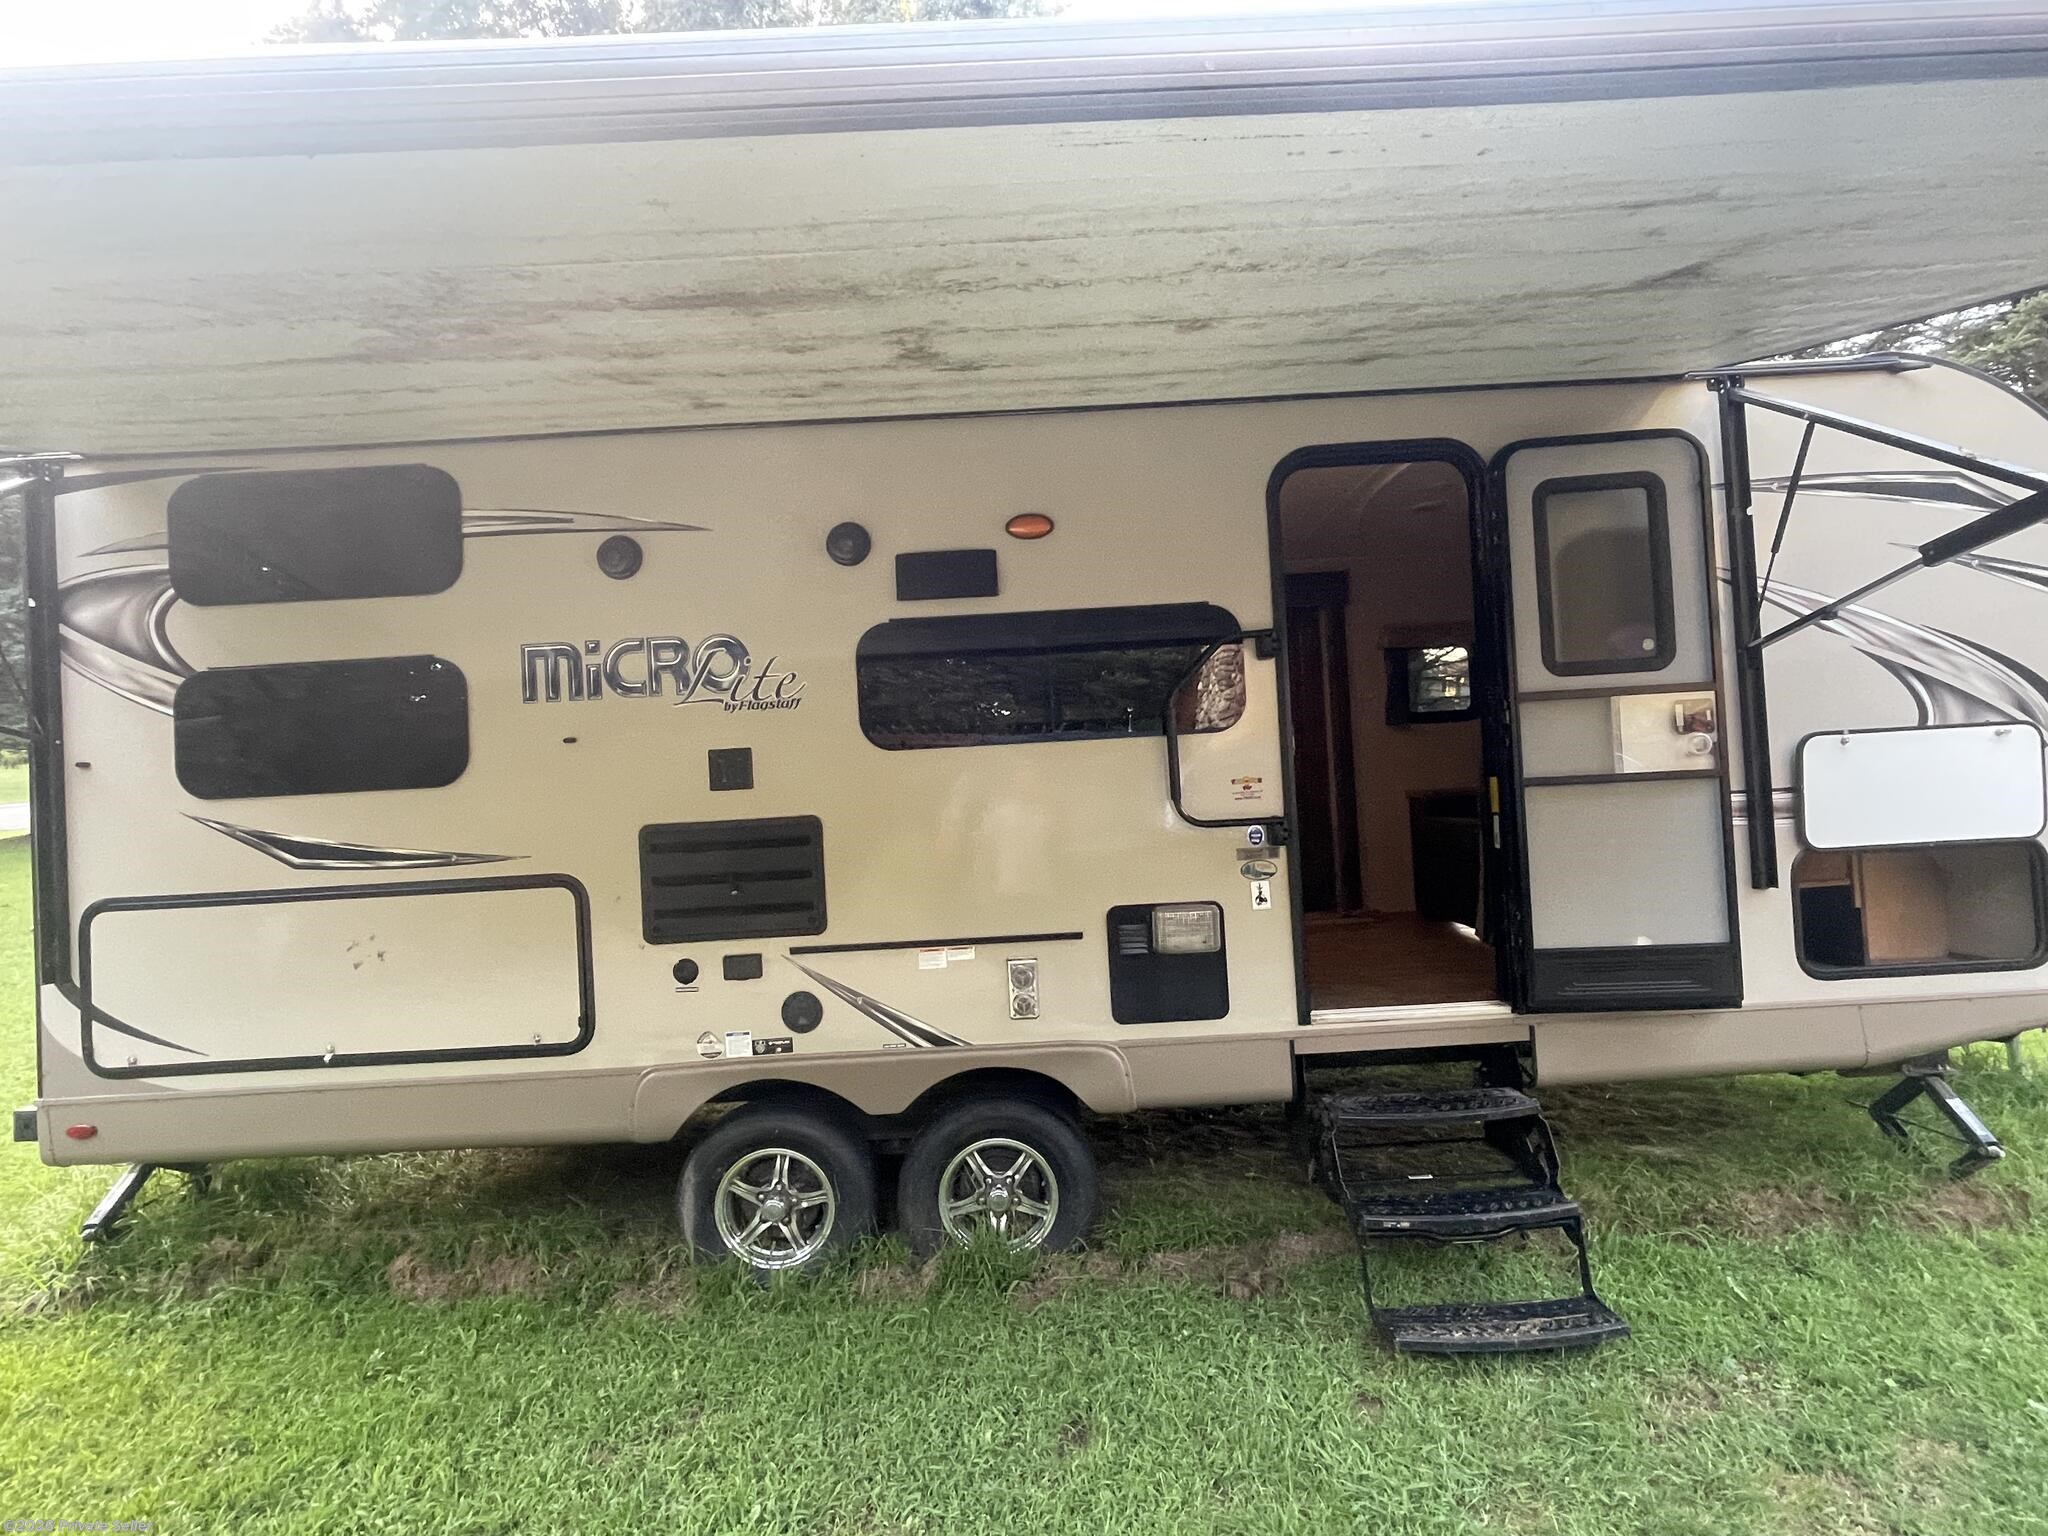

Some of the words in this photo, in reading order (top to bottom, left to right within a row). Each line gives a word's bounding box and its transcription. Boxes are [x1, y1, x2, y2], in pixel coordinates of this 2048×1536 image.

[673, 648, 807, 706] Lite
[723, 701, 738, 713] by
[738, 698, 802, 711] Flagstaff
